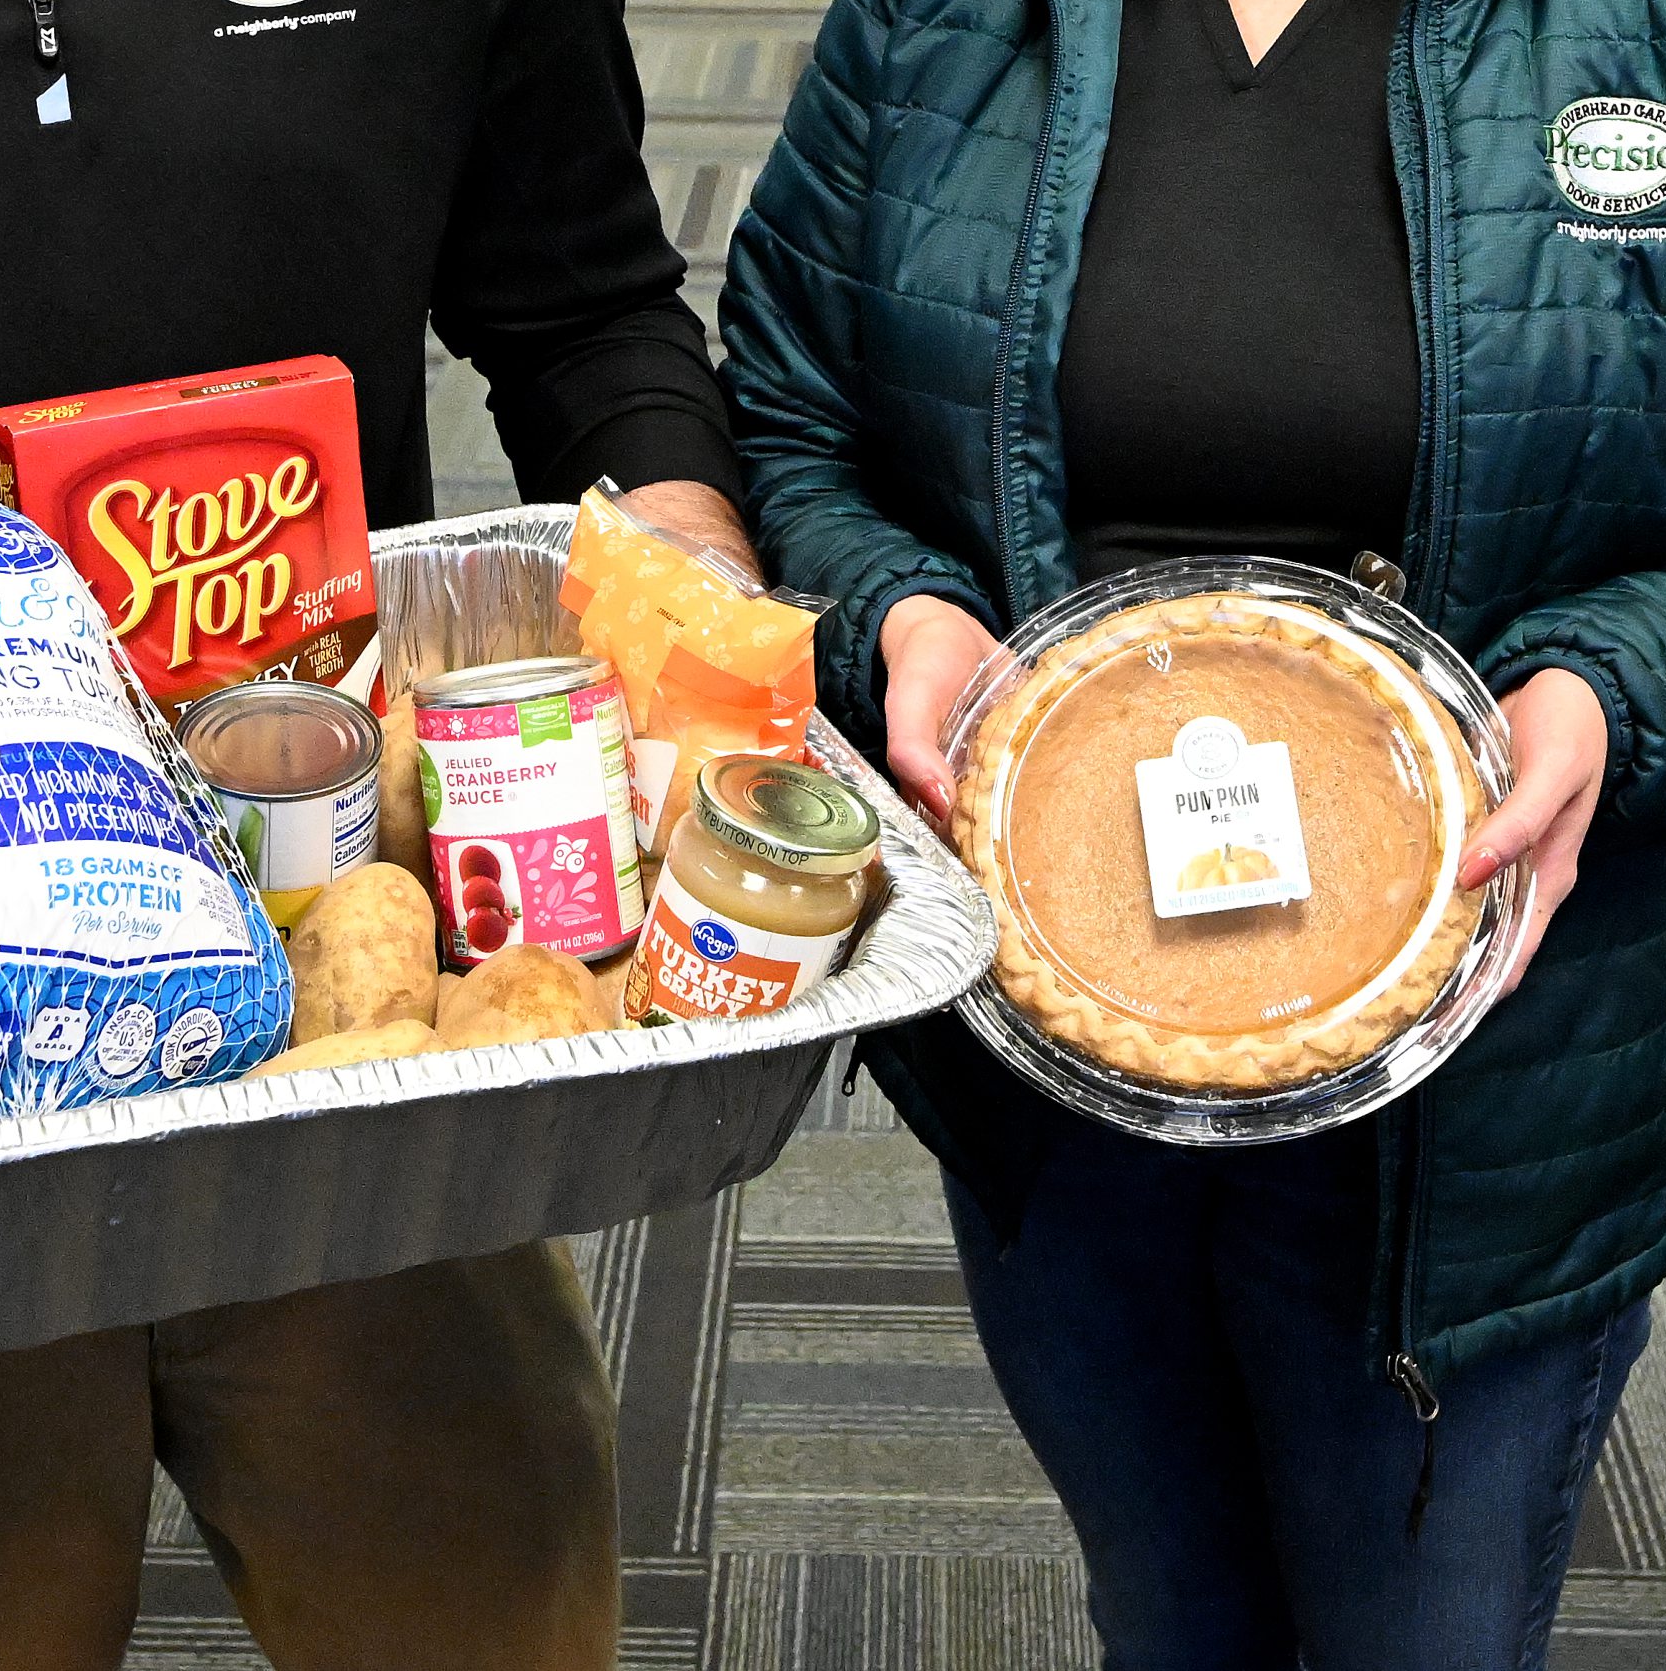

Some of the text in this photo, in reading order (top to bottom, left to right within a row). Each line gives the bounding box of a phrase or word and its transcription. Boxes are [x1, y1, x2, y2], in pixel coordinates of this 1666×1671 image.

[213, 27, 224, 37] a
[300, 9, 357, 25] company
[1561, 102, 1631, 129] OVERHEAD
[1566, 181, 1600, 210] DOOR
[18, 401, 87, 424] Stove
[86, 455, 320, 639] Stove
[293, 569, 363, 616] Stuffing
[153, 550, 294, 672] Top
[302, 604, 334, 633] Mix
[303, 631, 342, 658] with REAL
[309, 644, 342, 669] TURKEY
[315, 657, 345, 679] BROTH
[445, 757, 493, 770] JELLIED
[446, 762, 557, 788] CRANBERRY
[35, 768, 135, 801] HORMONES
[448, 789, 504, 806] SAUCE
[22, 799, 60, 833] NO
[66, 802, 182, 845] PRESERVATIVES
[335, 817, 358, 834] Serving
[1211, 813, 1232, 824] PIE
[334, 833, 371, 863] Calories
[710, 814, 755, 851] BUTTON
[757, 842, 779, 859] ON
[782, 849, 810, 866] TOP
[40, 857, 74, 878] 18
[82, 857, 158, 879] GRAMS
[47, 881, 183, 913] PROTEIN
[73, 910, 163, 941] Per Serving
[549, 940, 562, 951] WT
[563, 938, 572, 950] 14
[572, 936, 582, 947] OZ
[583, 930, 605, 946] (396g)
[693, 925, 735, 955] Kroger
[650, 919, 786, 1007] TURKEY
[658, 965, 747, 1020] GRAVY
[43, 1015, 81, 1024] USDA
[47, 1023, 65, 1041] A
[34, 1042, 74, 1051] GRADE
